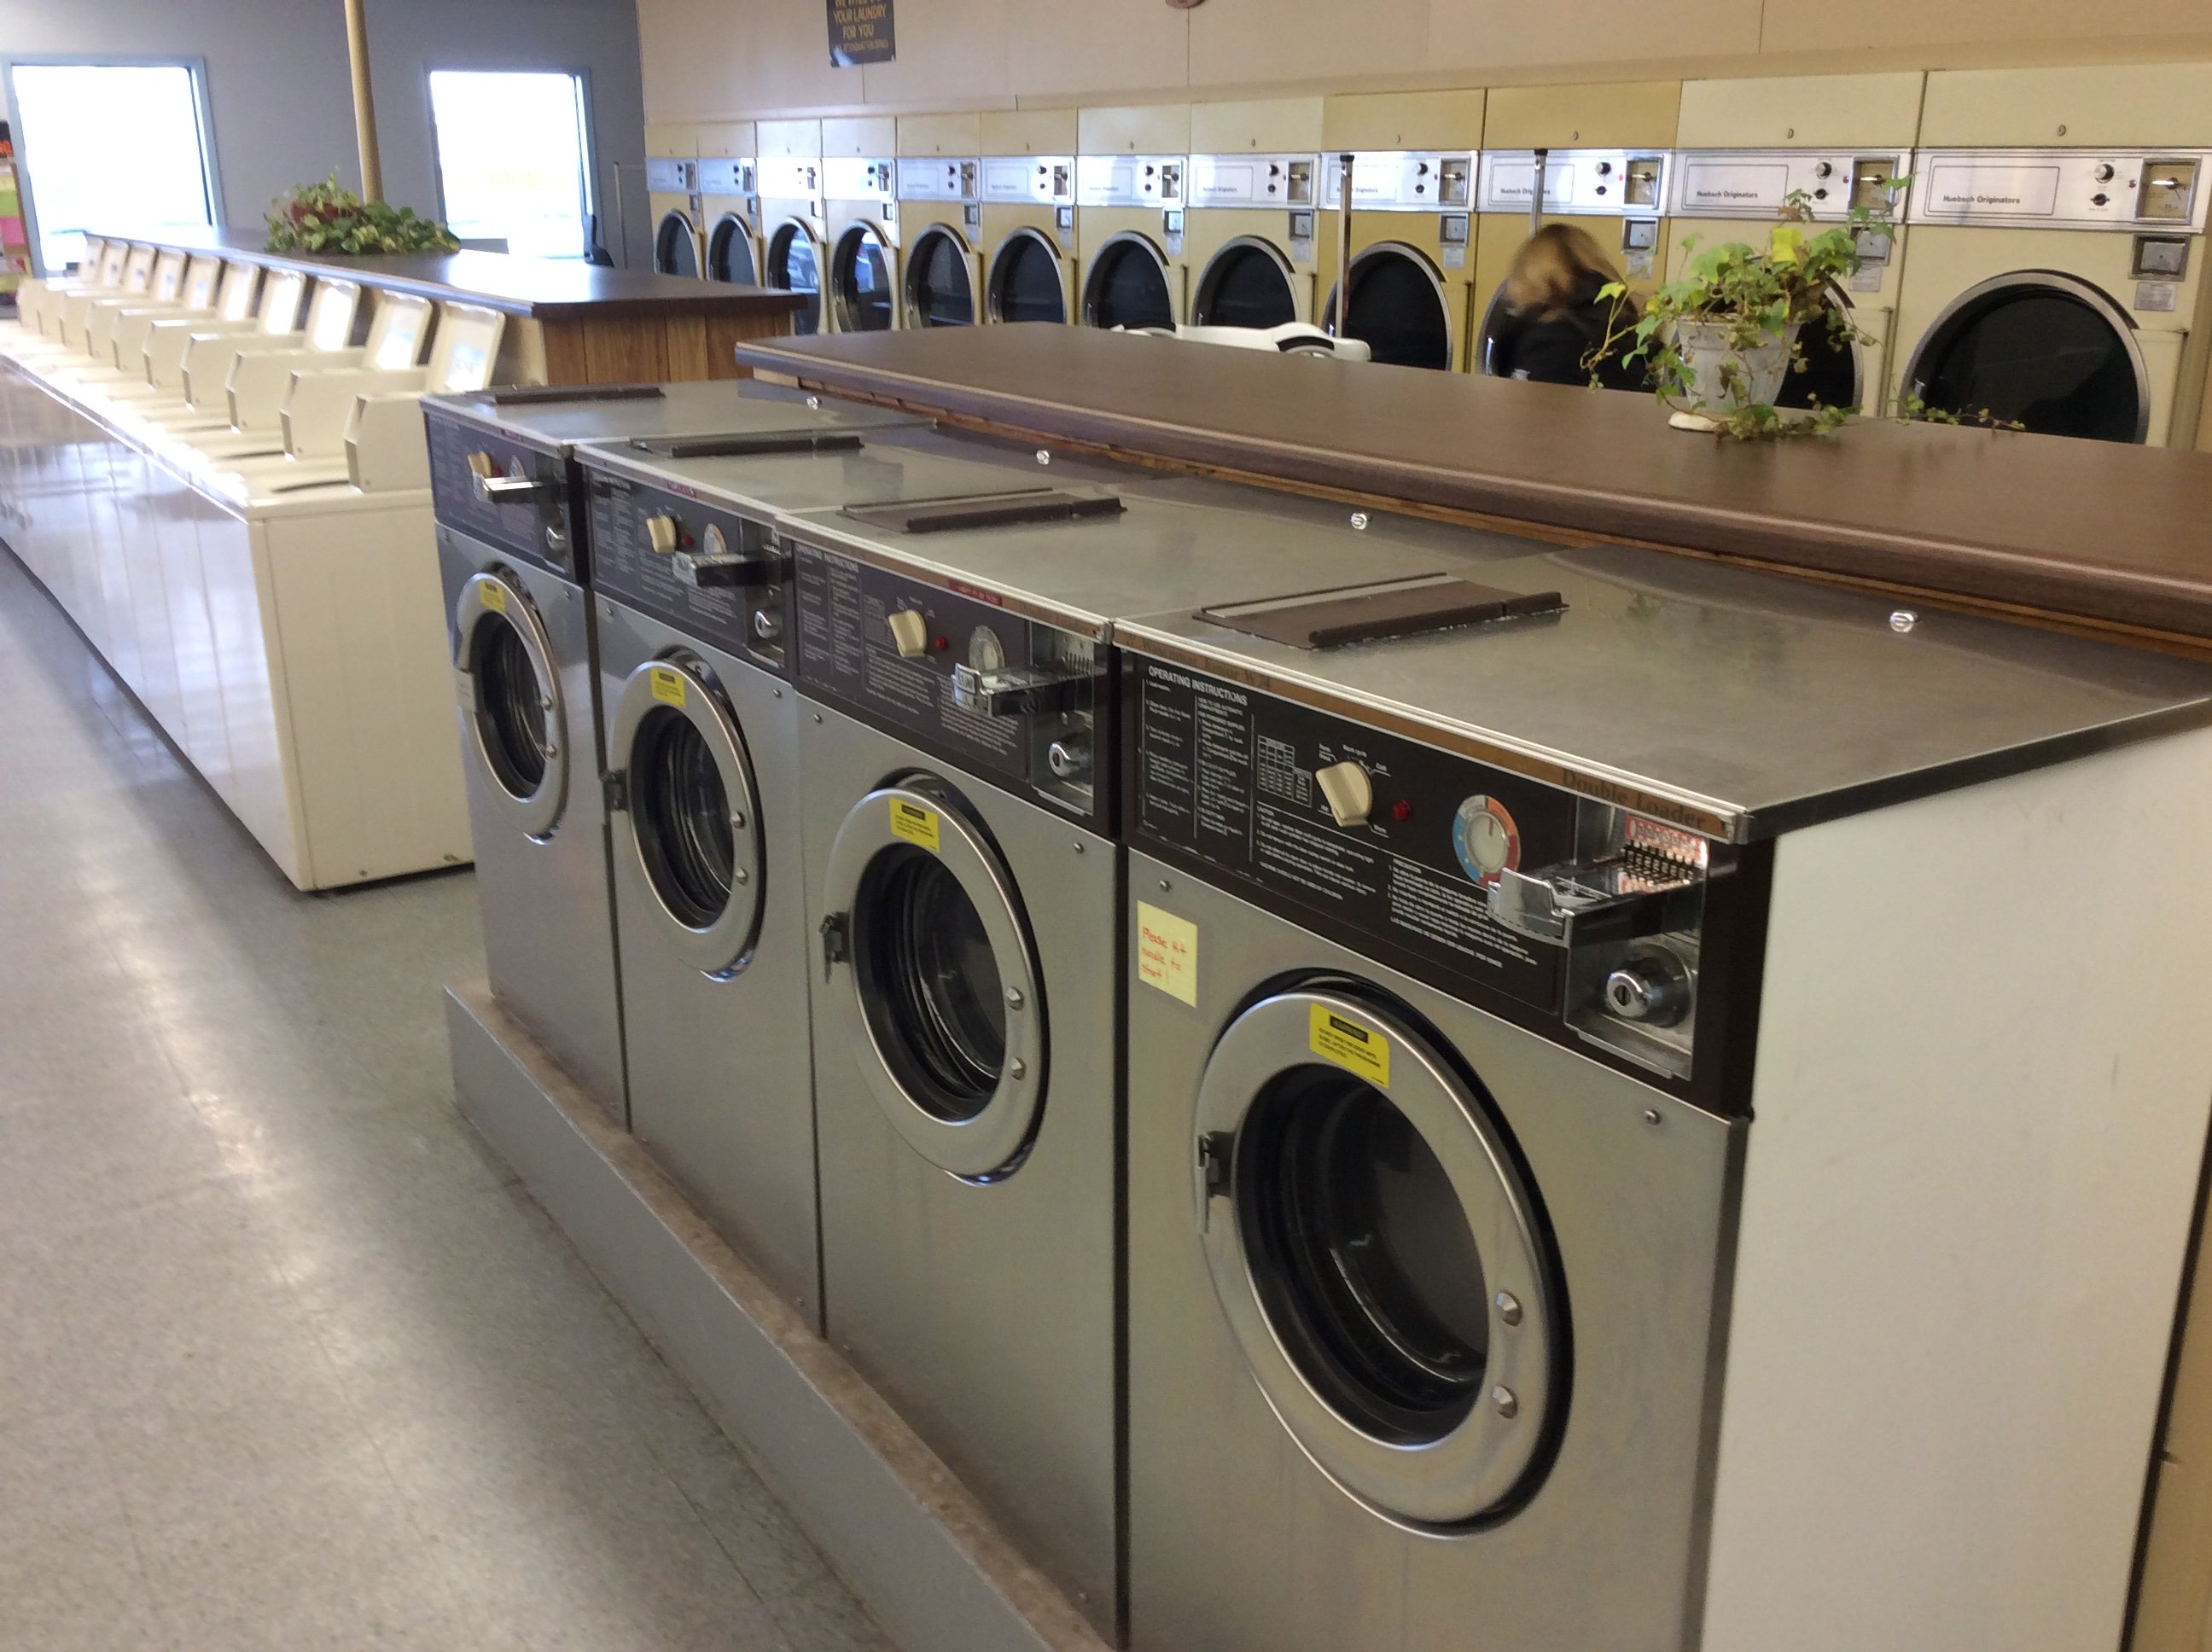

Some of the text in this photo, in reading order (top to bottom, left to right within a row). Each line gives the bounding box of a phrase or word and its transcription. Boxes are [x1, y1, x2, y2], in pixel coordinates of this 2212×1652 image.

[1976, 195, 2020, 204] Originators
[1148, 665, 1191, 688] OPERATING
[1191, 679, 1248, 706] INSTRUCTIONS
[1563, 769, 1706, 828] Double Loader
